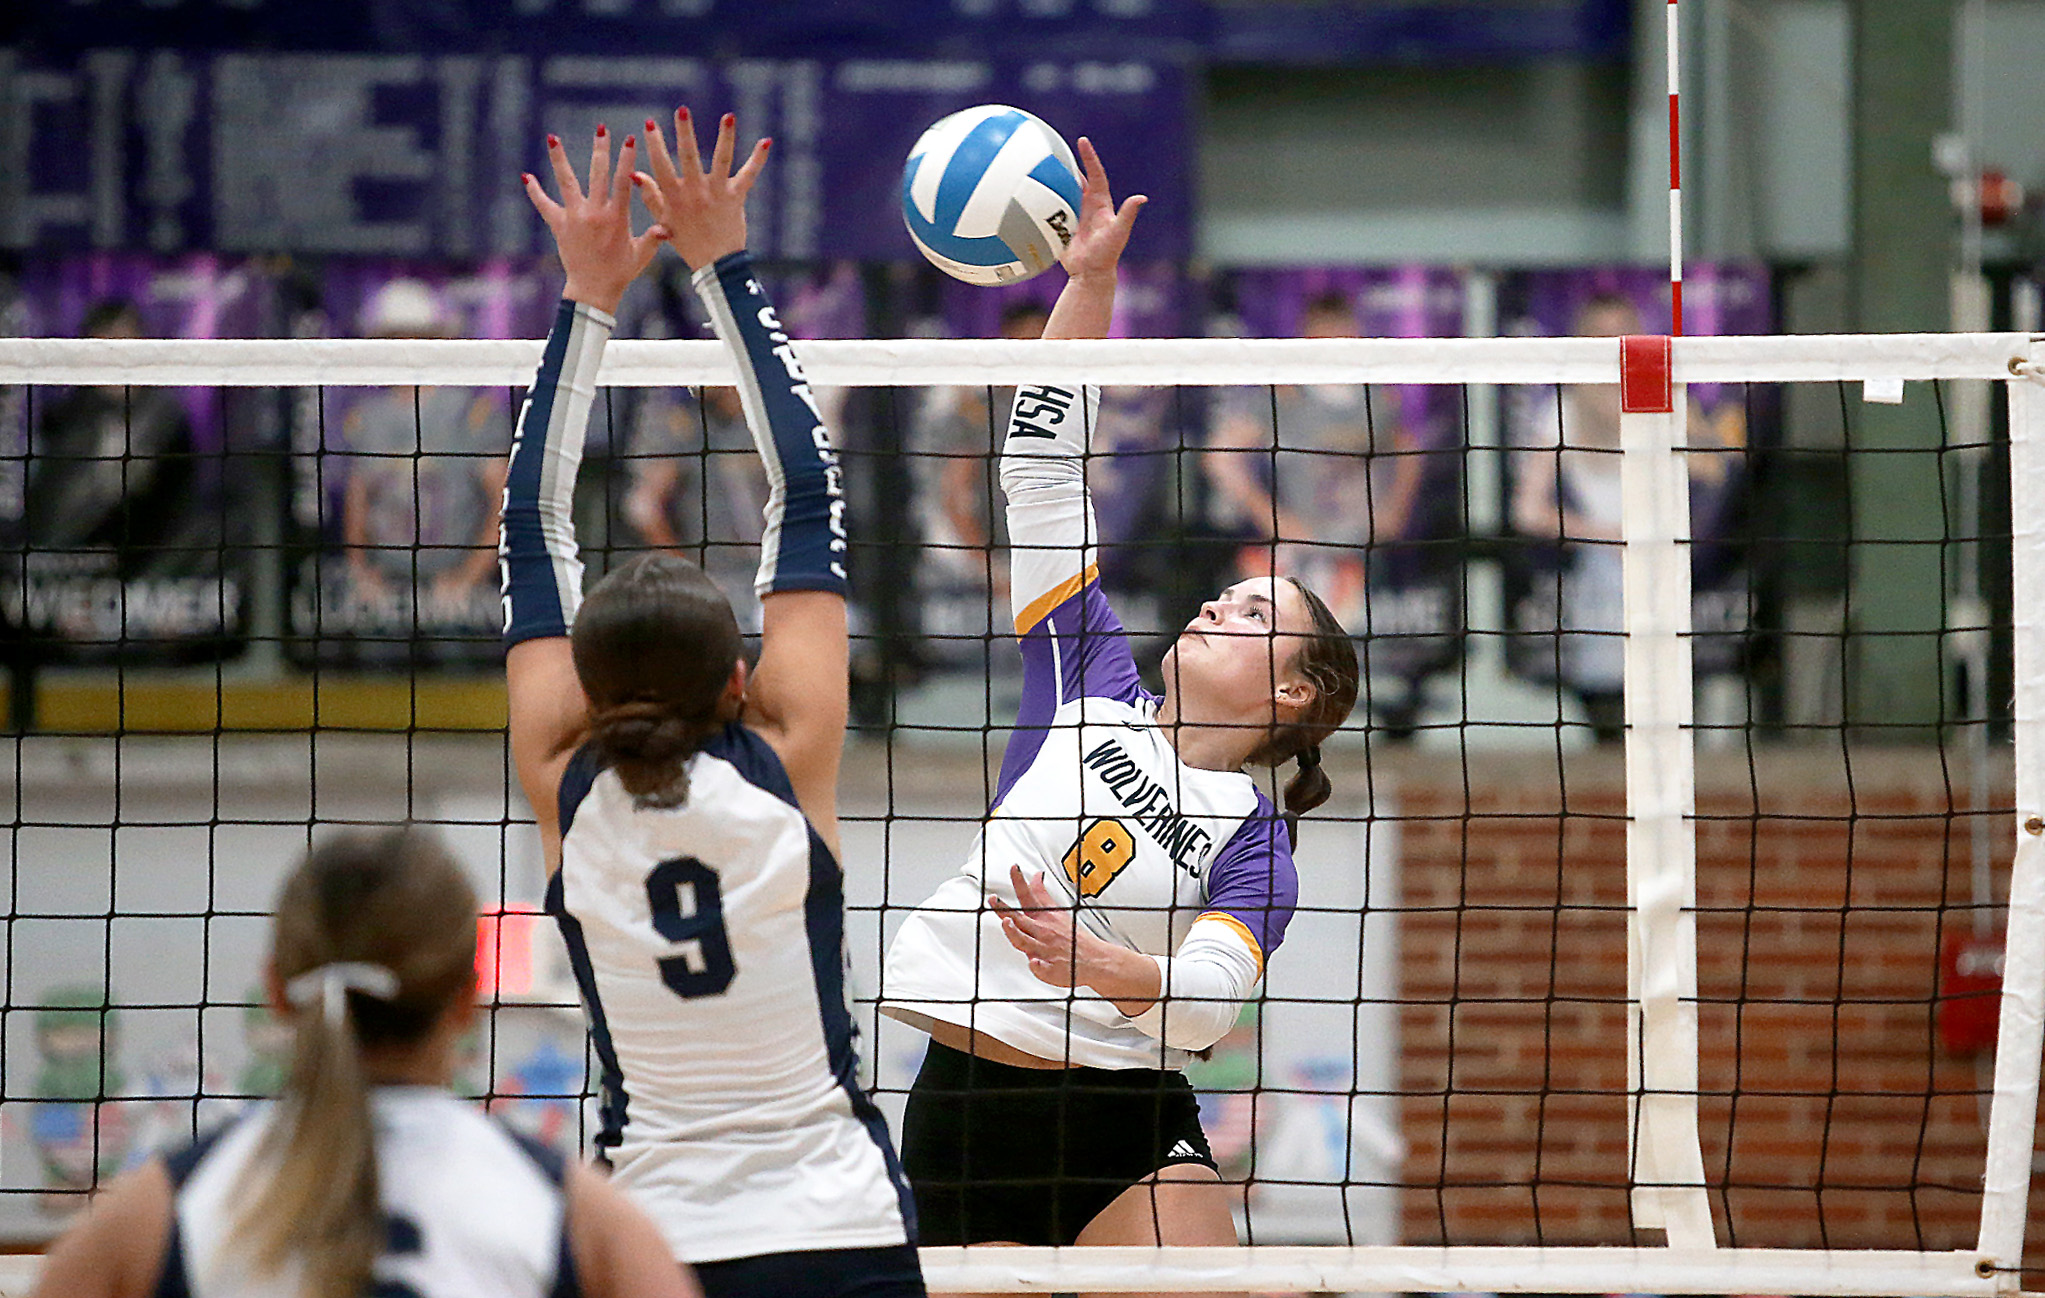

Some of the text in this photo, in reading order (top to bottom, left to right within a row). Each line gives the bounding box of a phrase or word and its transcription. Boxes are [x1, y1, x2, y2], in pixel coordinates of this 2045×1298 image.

[1061, 817, 1136, 898] 8
[1082, 739, 1213, 879] WOLVERINES
[645, 856, 737, 1000] 9
